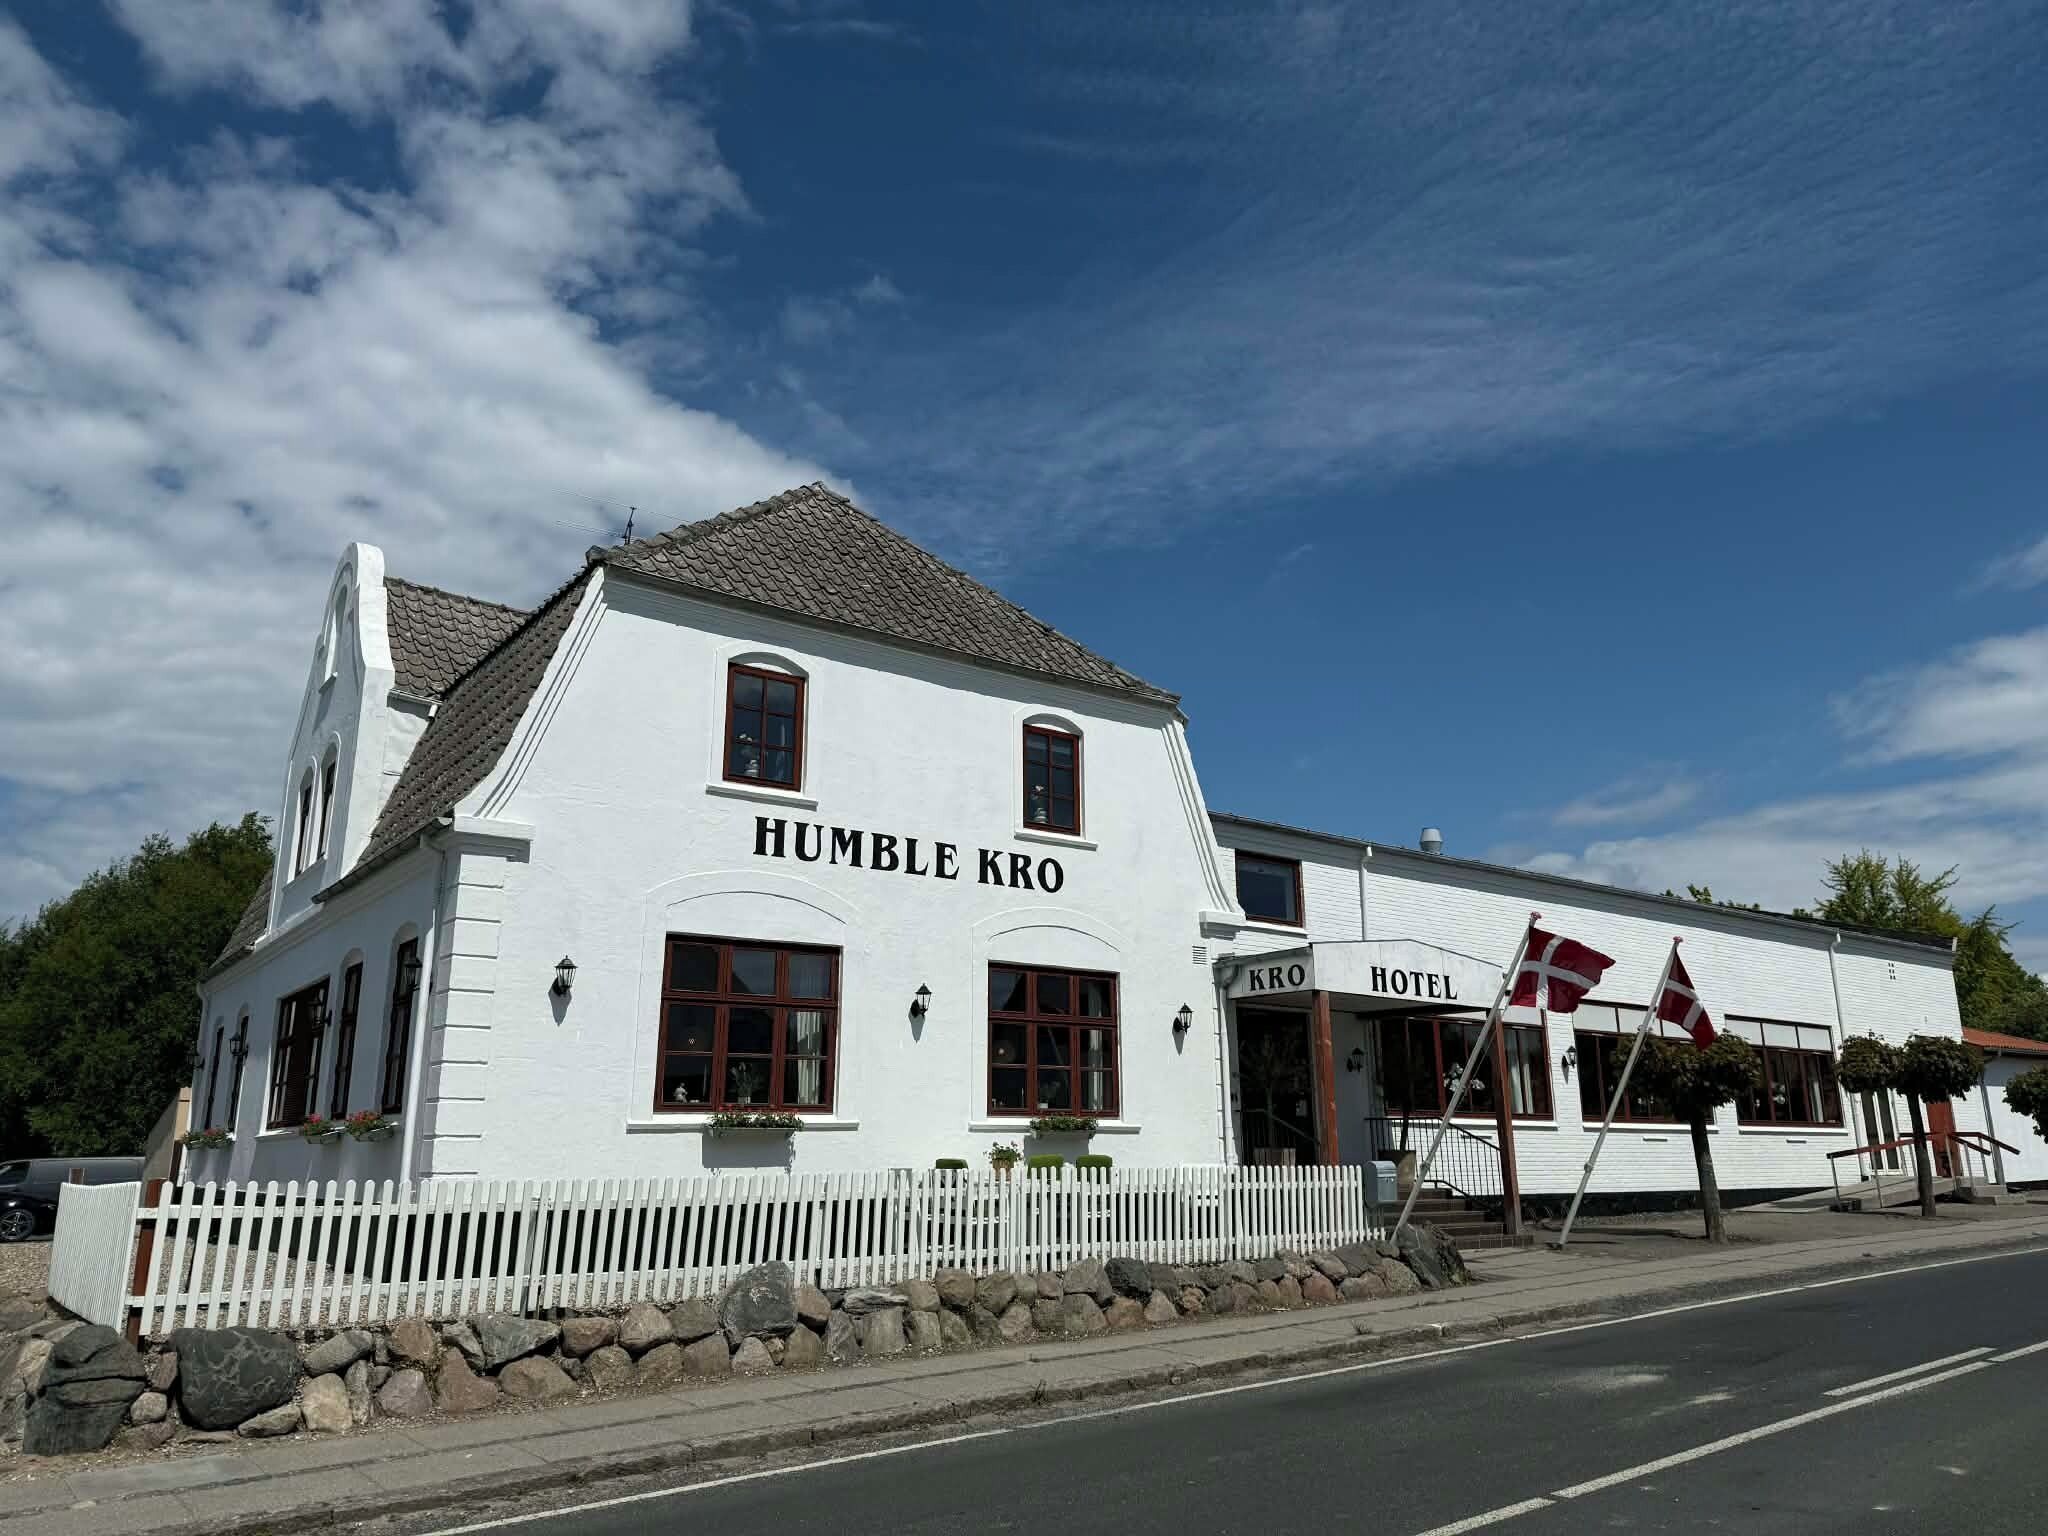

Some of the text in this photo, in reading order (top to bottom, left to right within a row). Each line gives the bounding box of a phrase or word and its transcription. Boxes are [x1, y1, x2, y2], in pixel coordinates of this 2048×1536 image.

[753, 816, 1064, 893] HUMBLE KRO
[1249, 964, 1306, 991] KRO
[1370, 966, 1458, 1000] HOTEL
